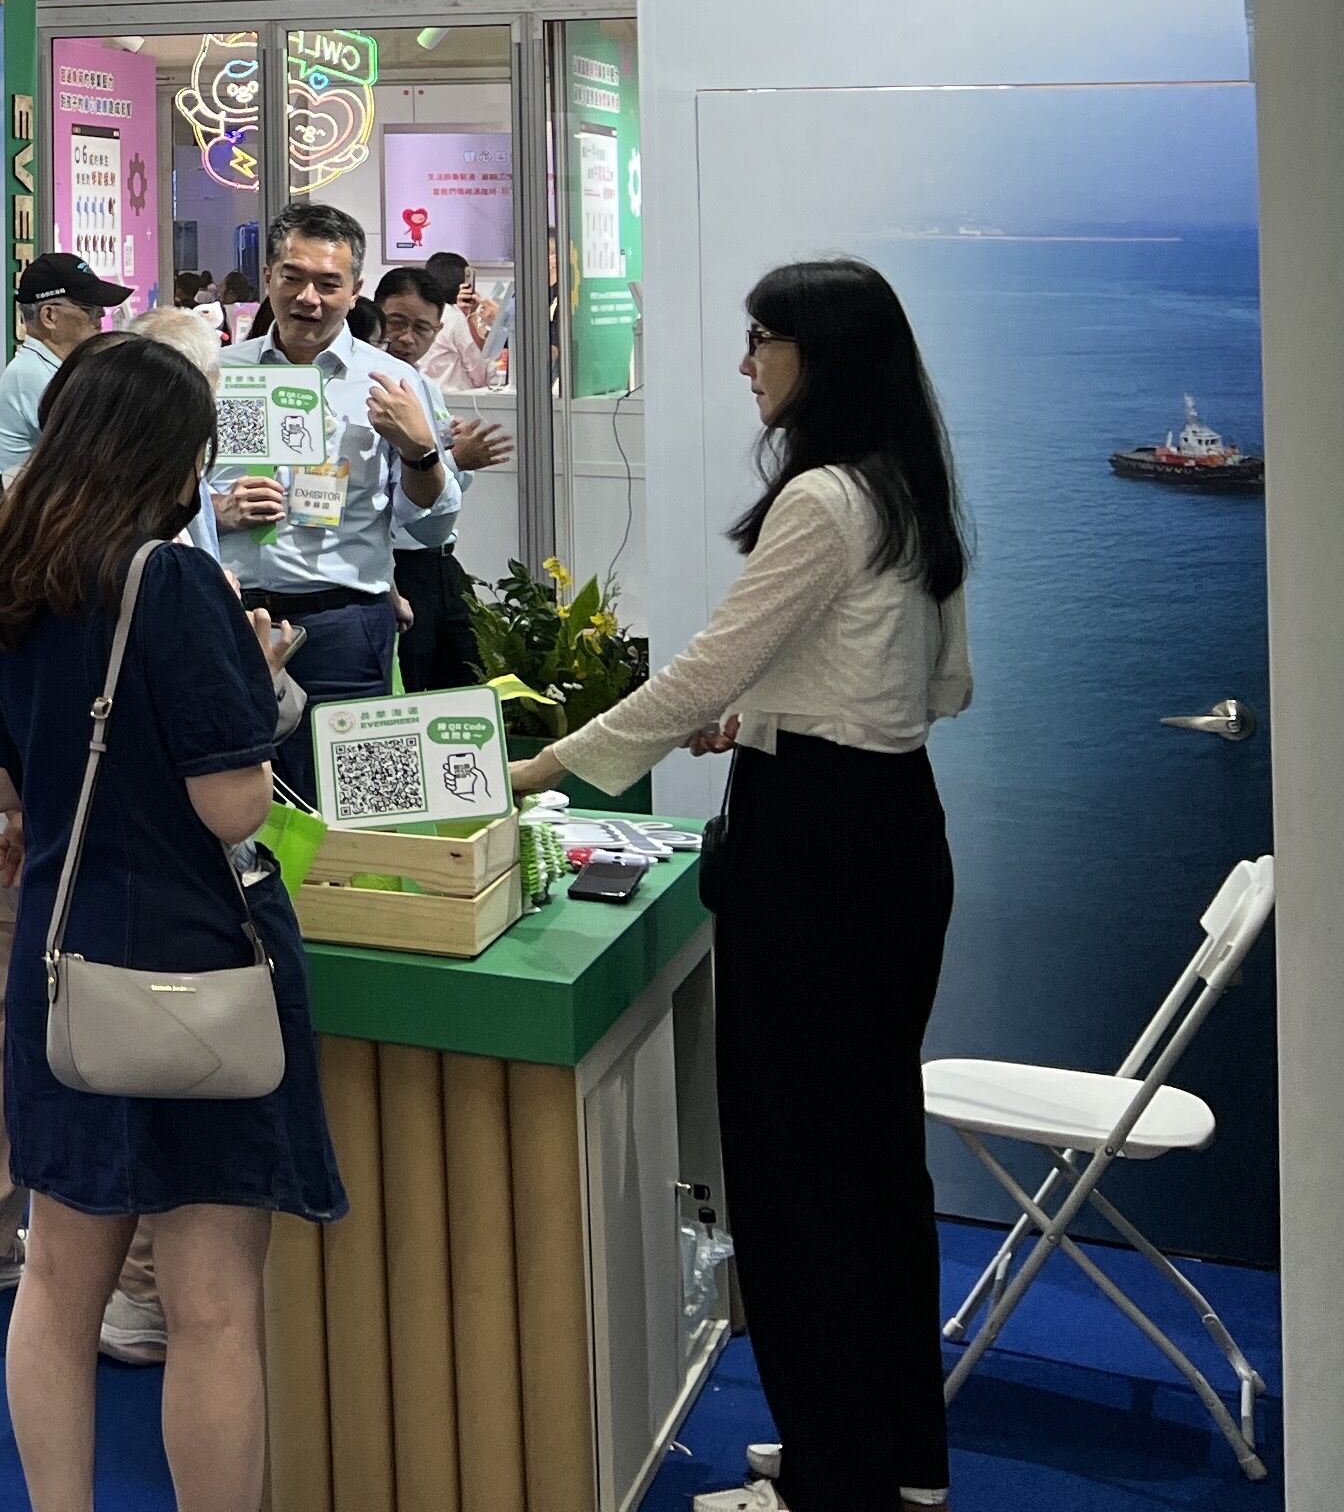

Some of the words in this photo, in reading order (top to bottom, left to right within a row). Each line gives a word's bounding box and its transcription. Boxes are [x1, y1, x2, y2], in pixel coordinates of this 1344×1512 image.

[295, 488, 341, 501] EXHIBITOR
[360, 716, 419, 729] EVERGREEN
[463, 723, 487, 731] Code
